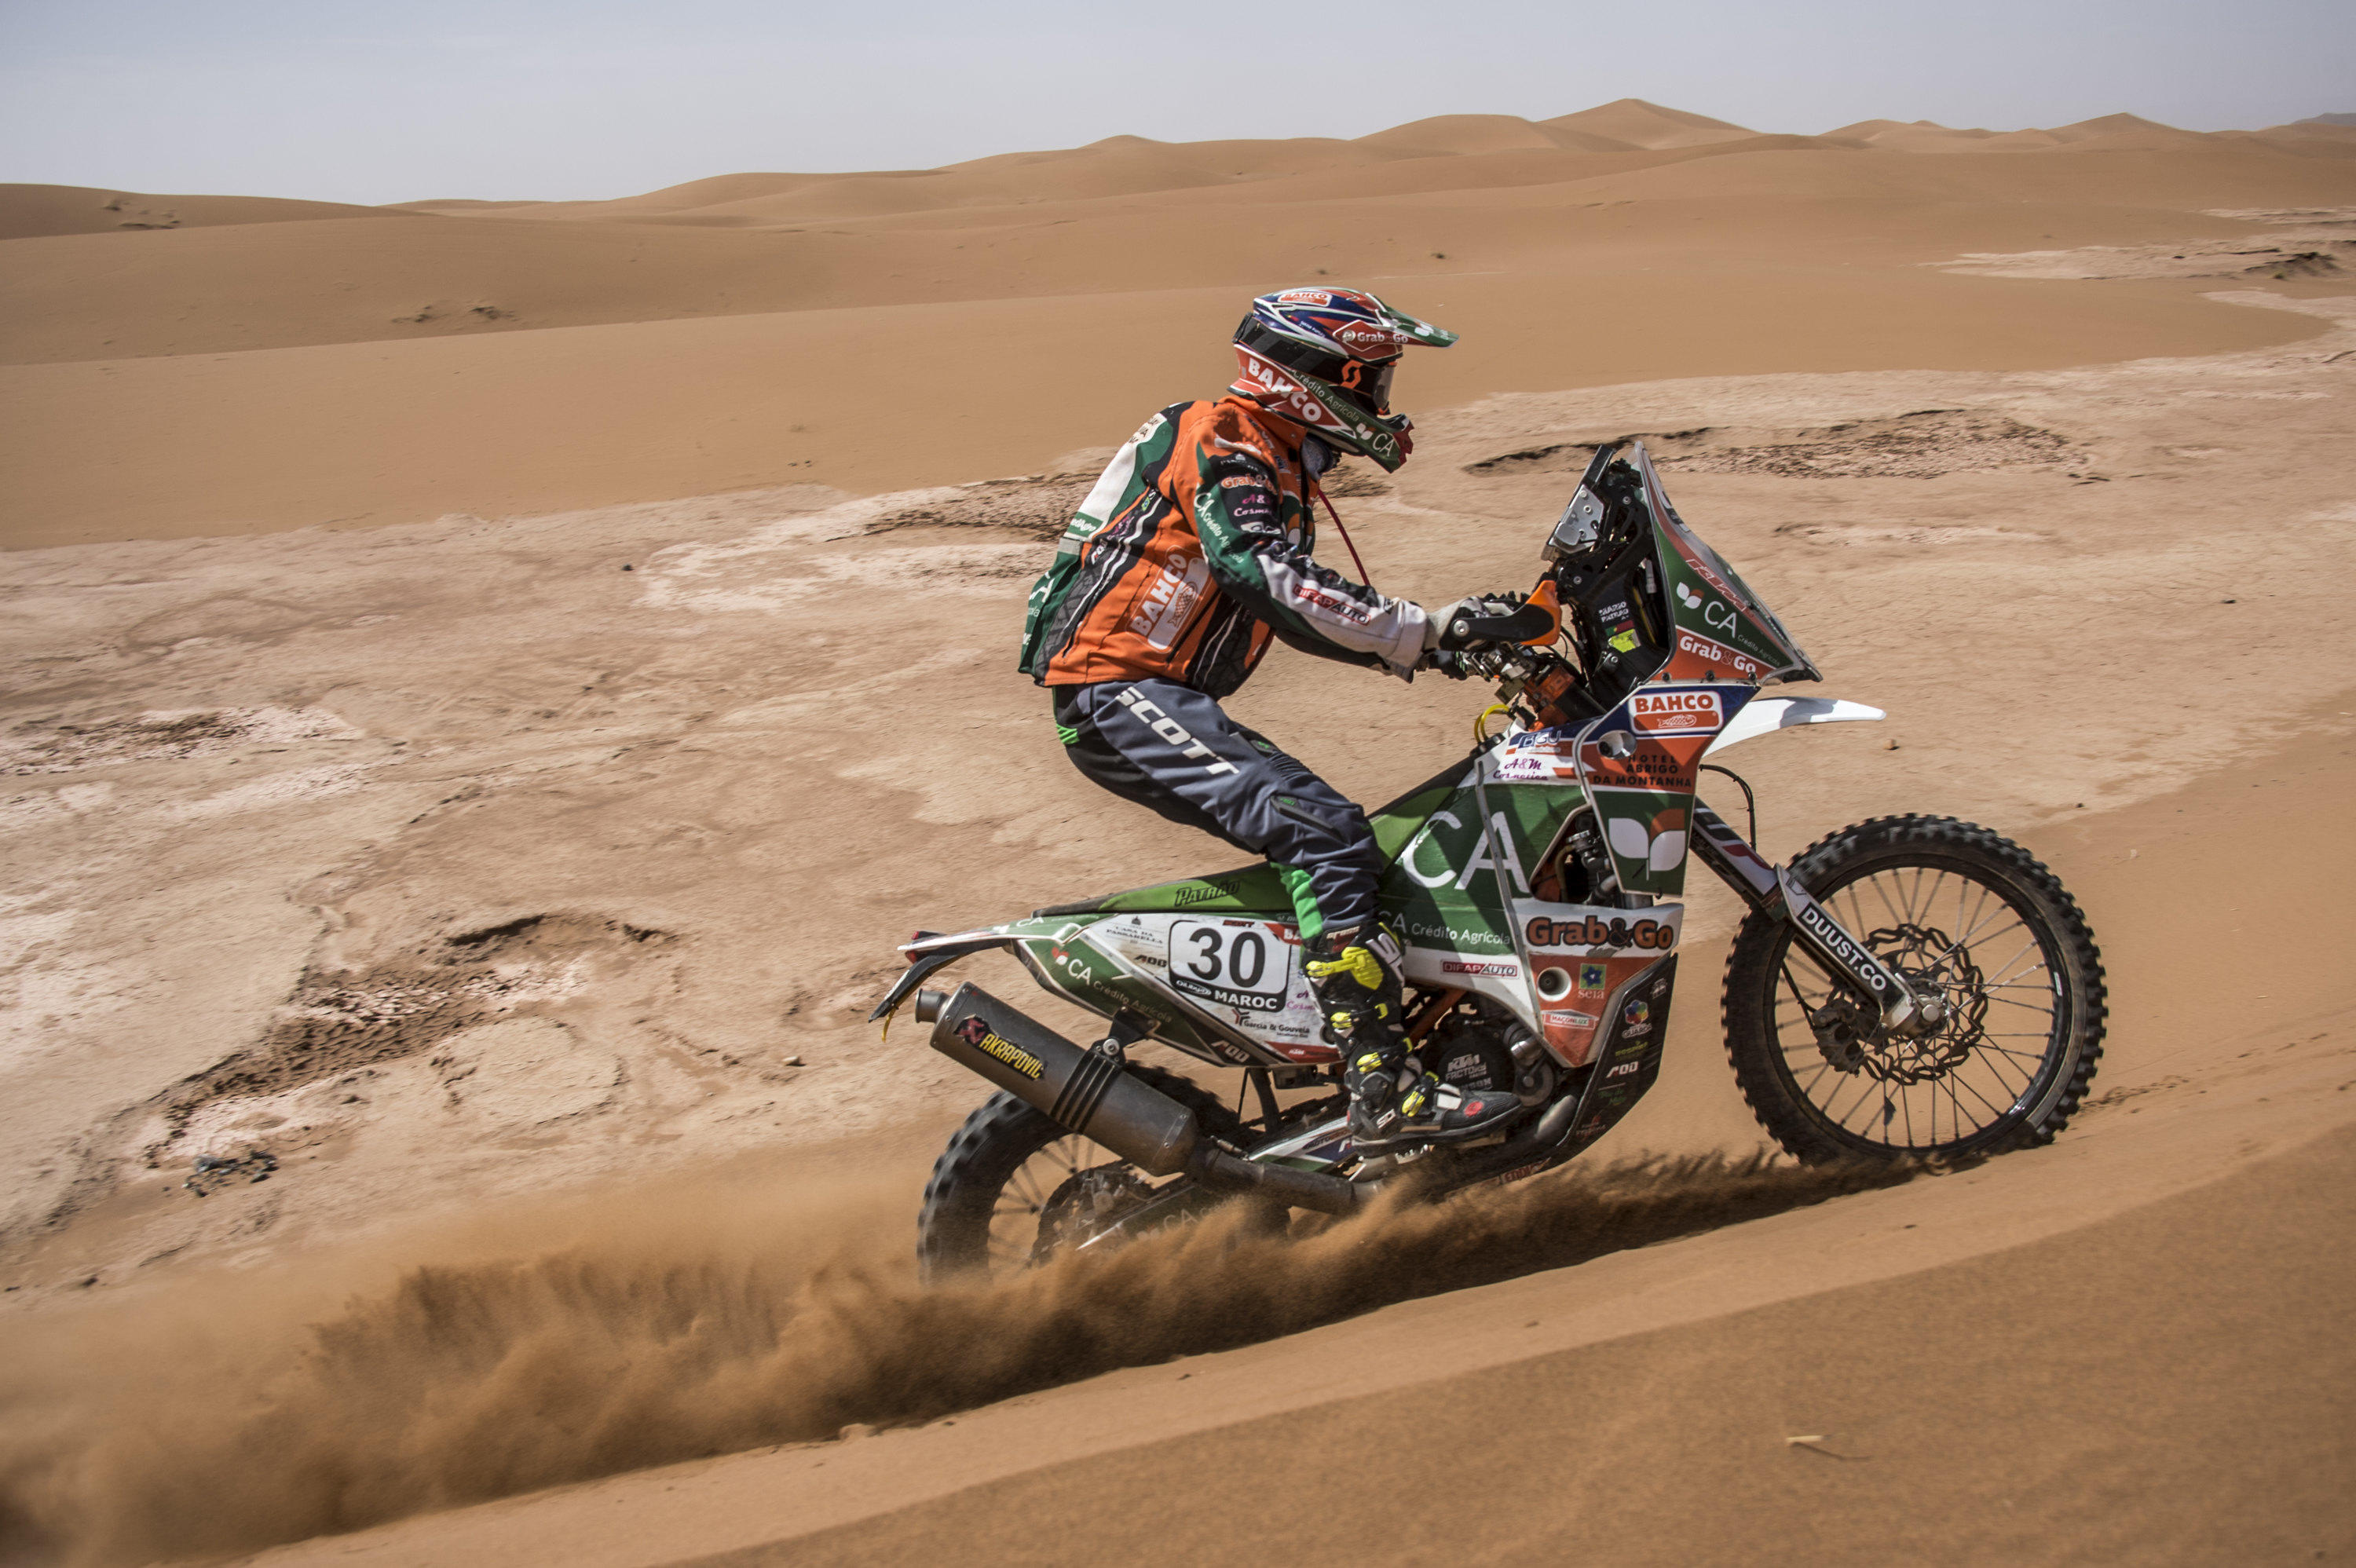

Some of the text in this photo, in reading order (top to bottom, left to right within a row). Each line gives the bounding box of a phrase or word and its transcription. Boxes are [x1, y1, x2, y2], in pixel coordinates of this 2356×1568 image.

[1357, 331, 1408, 343] Grab Go
[1247, 357, 1323, 422] BAHCO
[1372, 433, 1396, 456] CA
[1194, 492, 1215, 517] CA
[1131, 554, 1187, 636] BAHCO
[1332, 602, 1369, 623] AUTO
[1704, 601, 1737, 638] CA
[1634, 694, 1714, 713] BAHCO
[1115, 686, 1240, 776] SCOTT
[1626, 764, 1678, 773] ABRIGO
[1628, 755, 1676, 763] HOTEL
[1593, 776, 1692, 787] DA MONTANHA
[1401, 810, 1531, 893] CA
[1411, 923, 1458, 940] Crédito
[1461, 929, 1510, 945] Agrícola
[1526, 916, 1674, 948] Grab&Go
[1187, 927, 1265, 988] 30
[1802, 907, 1886, 991] DUUST.CO
[1068, 959, 1092, 985] CA
[1443, 963, 1516, 976] DIFAP AUTO
[1214, 990, 1278, 1010] MAROC
